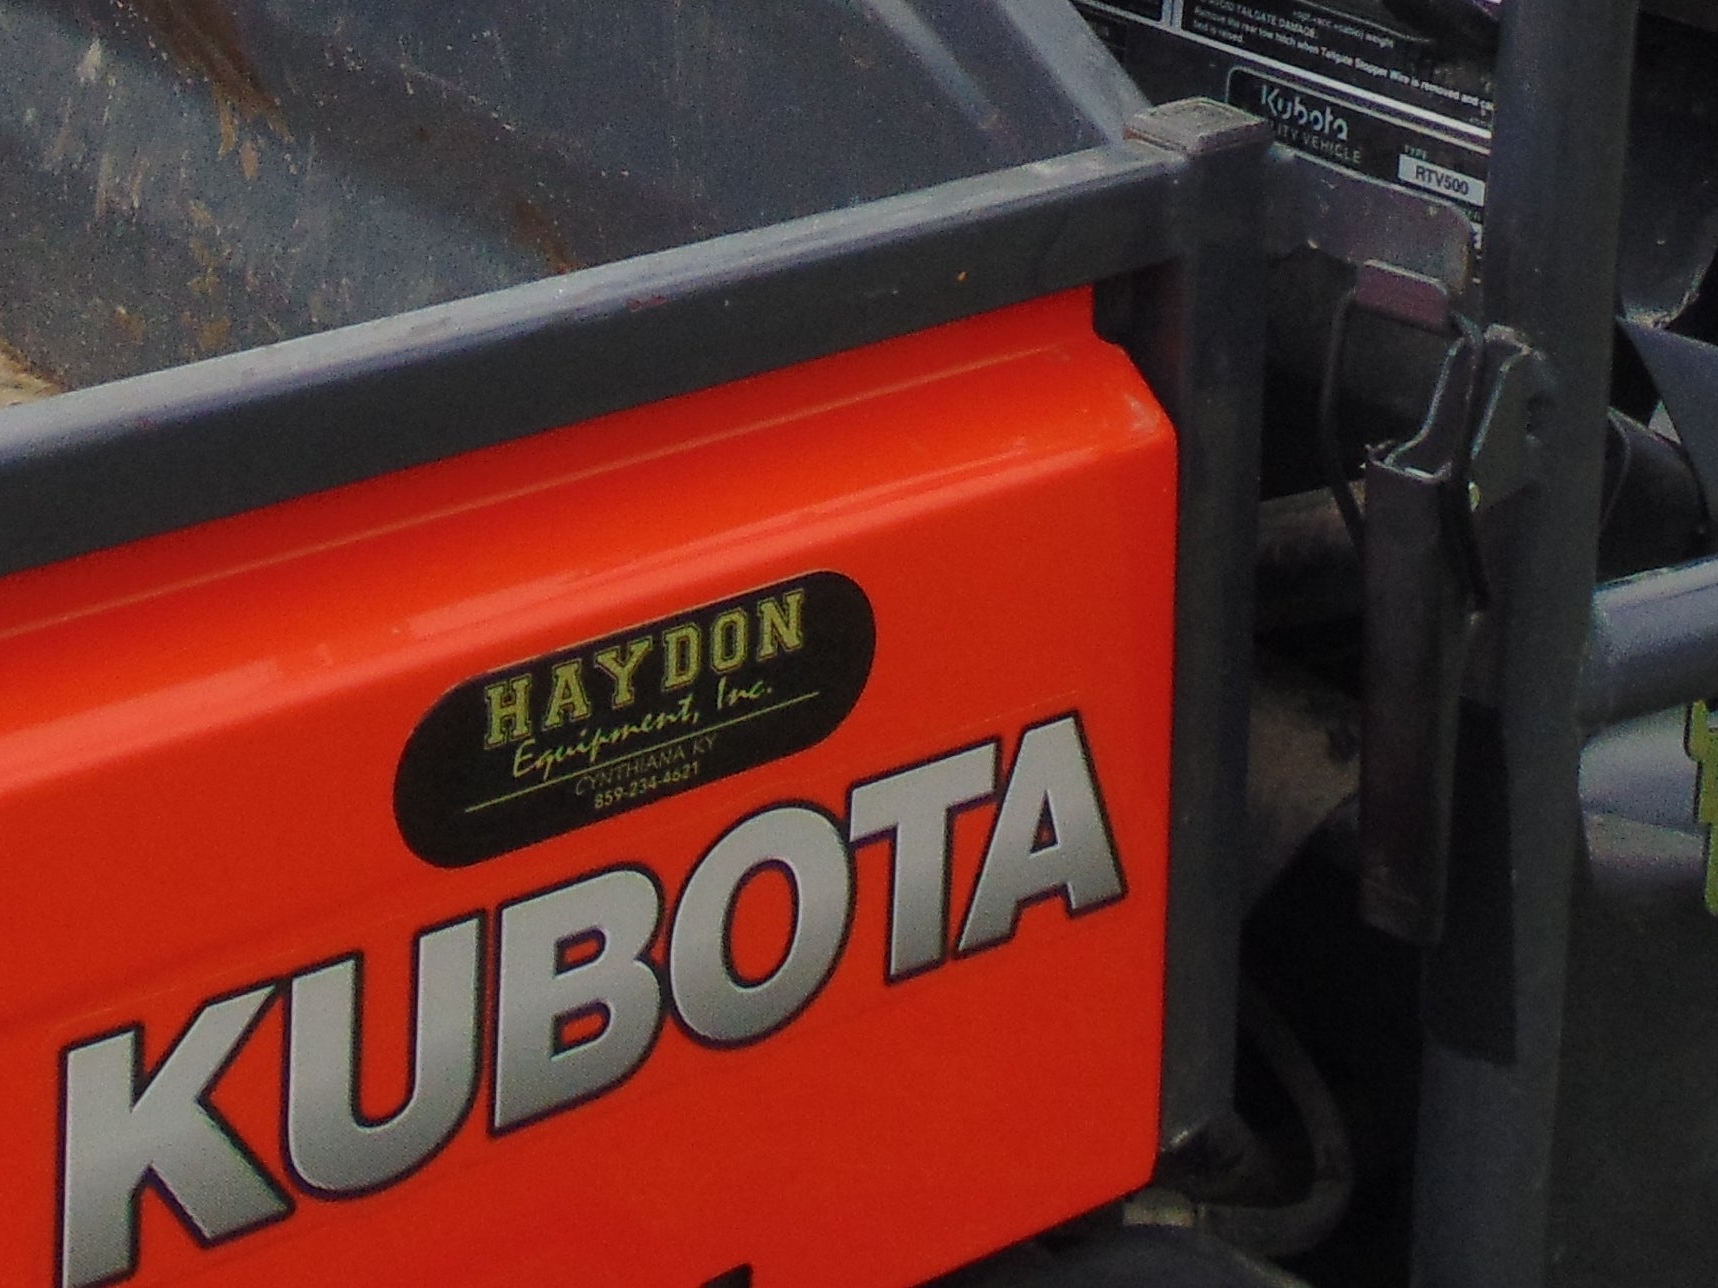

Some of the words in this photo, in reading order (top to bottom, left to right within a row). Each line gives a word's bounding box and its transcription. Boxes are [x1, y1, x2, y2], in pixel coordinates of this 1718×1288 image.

[1235, 2, 1277, 25] TAILGATE
[1296, 37, 1319, 55] when
[1320, 46, 1353, 67] Tailgate
[1355, 57, 1388, 78] Stopper
[1389, 67, 1410, 84] Wire
[1410, 74, 1419, 87] is
[1420, 78, 1460, 101] removed
[1461, 93, 1479, 107] and
[1261, 84, 1348, 141] Kubota
[1303, 131, 1361, 165] VEHICLE
[1404, 144, 1429, 160] TYPE
[1415, 165, 1470, 196] RTV500
[484, 587, 805, 750] HAYDON
[512, 698, 701, 779] Equipment,
[713, 676, 774, 712] Inc.
[574, 744, 686, 798] CYNTHIANA
[690, 733, 718, 760] KY
[594, 761, 700, 810] 859-234-4621
[56, 710, 1129, 1288] KUBOTA
